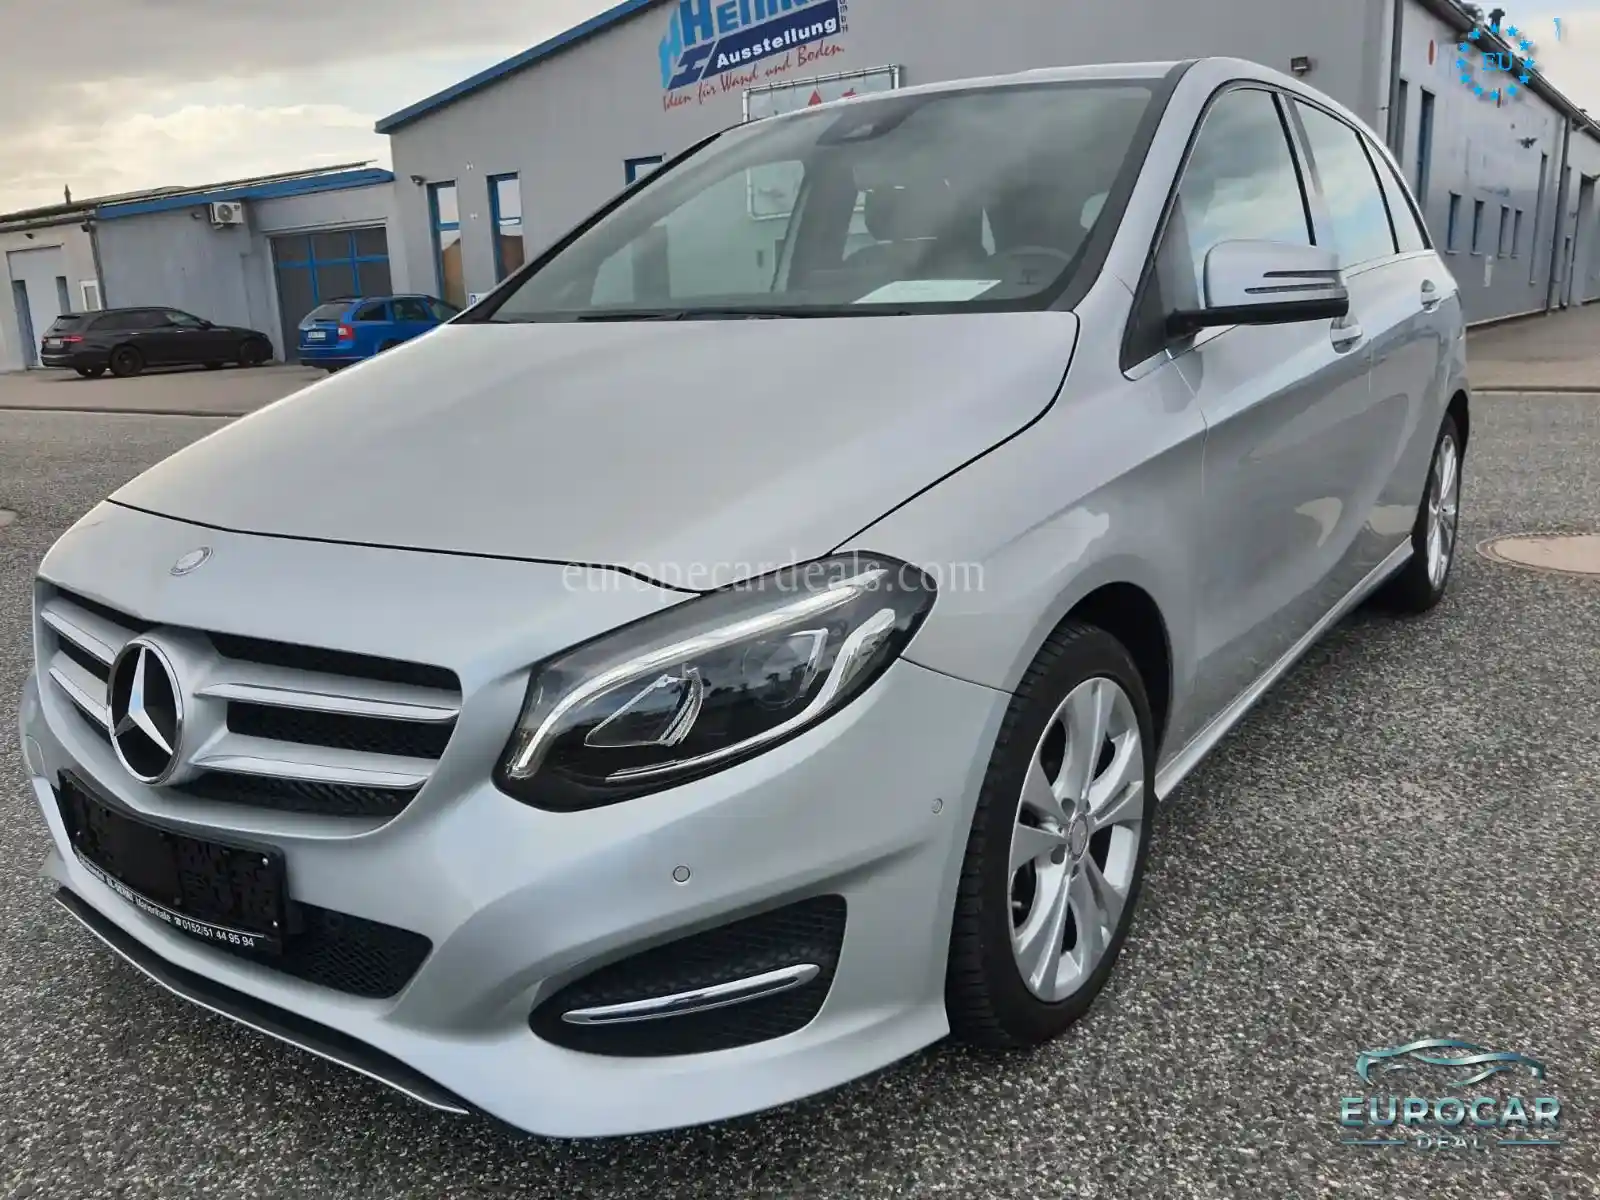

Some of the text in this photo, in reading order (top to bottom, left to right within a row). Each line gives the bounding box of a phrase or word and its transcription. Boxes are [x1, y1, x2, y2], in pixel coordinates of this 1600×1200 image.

[717, 17, 837, 68] Ausstellung
[663, 95, 693, 112] Ideen
[699, 80, 717, 105] für
[721, 63, 758, 92] Wand
[765, 58, 792, 77] und
[216, 930, 227, 941] 44
[228, 934, 240, 944] 95
[242, 936, 254, 947] 94
